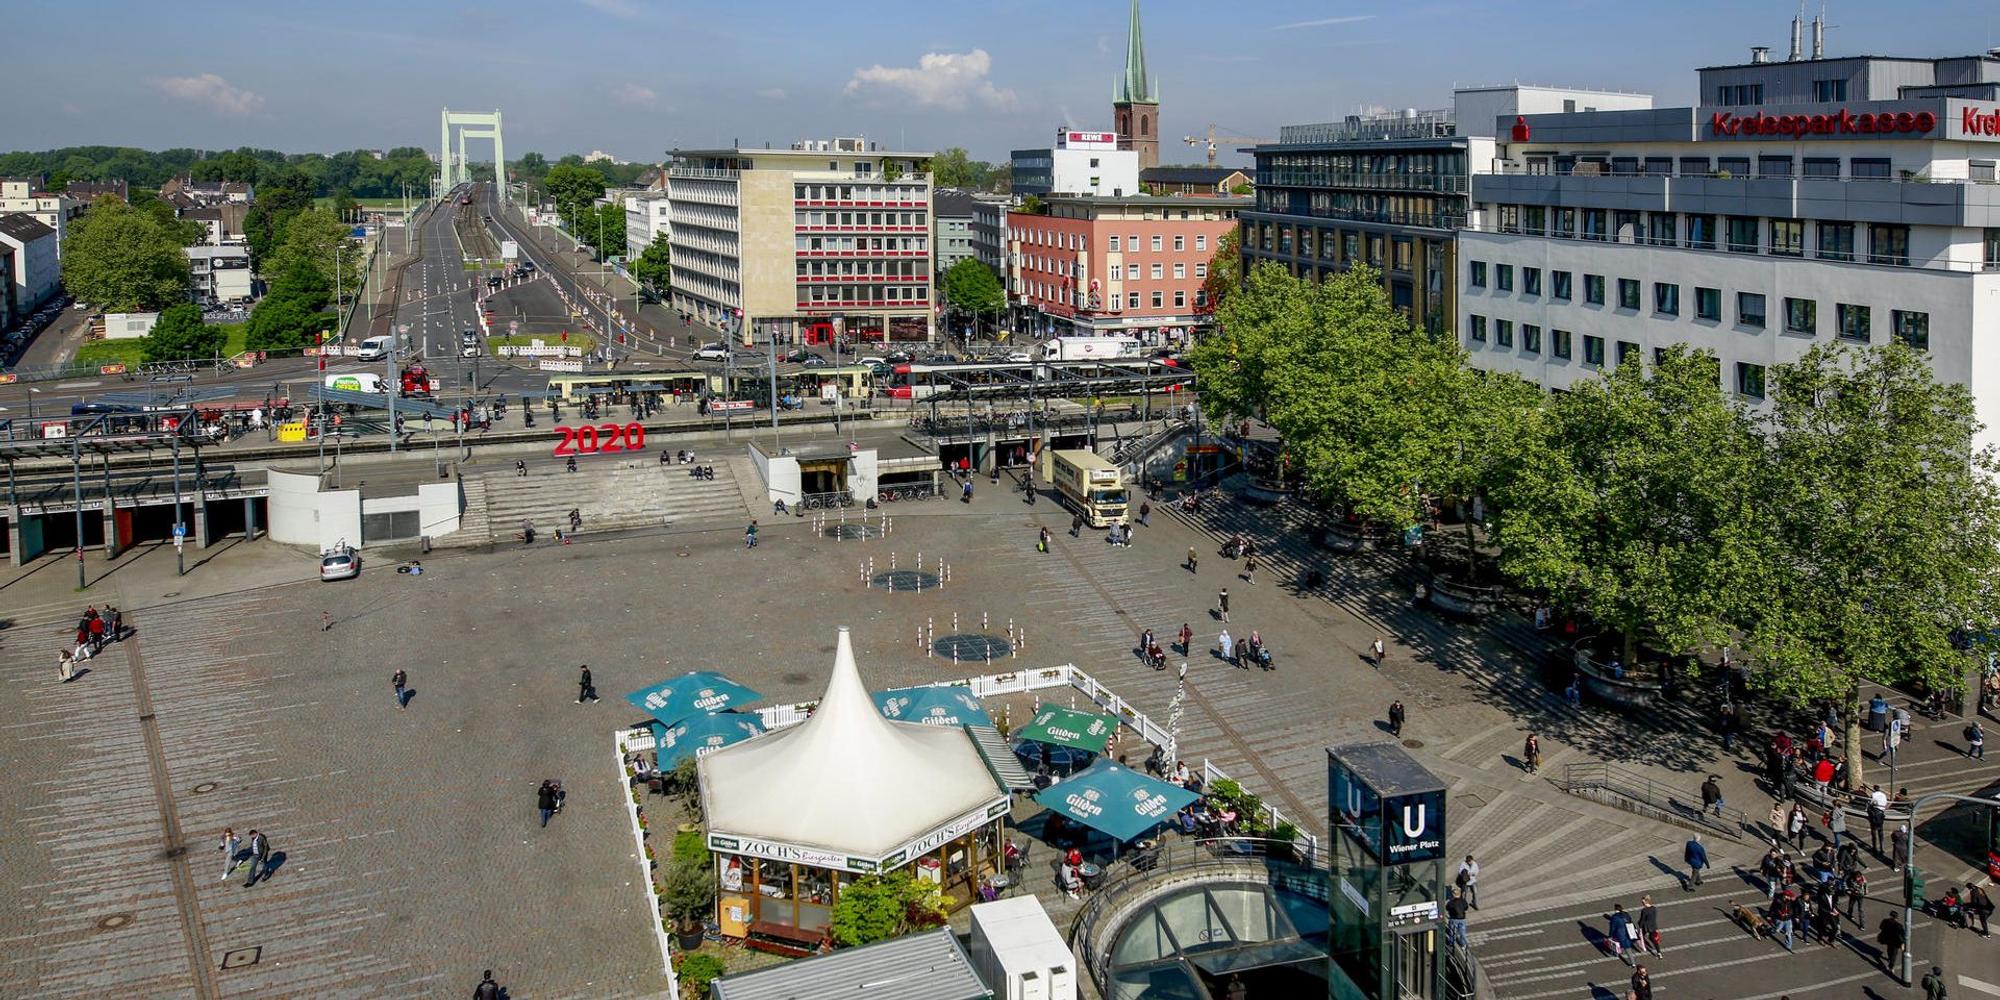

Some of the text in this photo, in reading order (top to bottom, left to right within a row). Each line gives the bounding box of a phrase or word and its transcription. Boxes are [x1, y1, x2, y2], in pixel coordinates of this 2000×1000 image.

[1713, 107, 1936, 139] Kreissparkasse
[1082, 133, 1102, 141] REWE
[553, 422, 646, 456] 2020
[694, 693, 730, 709] Gilden
[1047, 726, 1080, 739] Gilden
[1066, 793, 1103, 816] Gilden
[1135, 794, 1168, 816] Gilden
[1348, 781, 1361, 818] U
[1404, 804, 1425, 838] U
[744, 841, 801, 860] ZOCH'S
[802, 850, 843, 864] Biergarten
[910, 825, 955, 857] ZOCH'S
[1390, 841, 1440, 854] Wiener Platz
